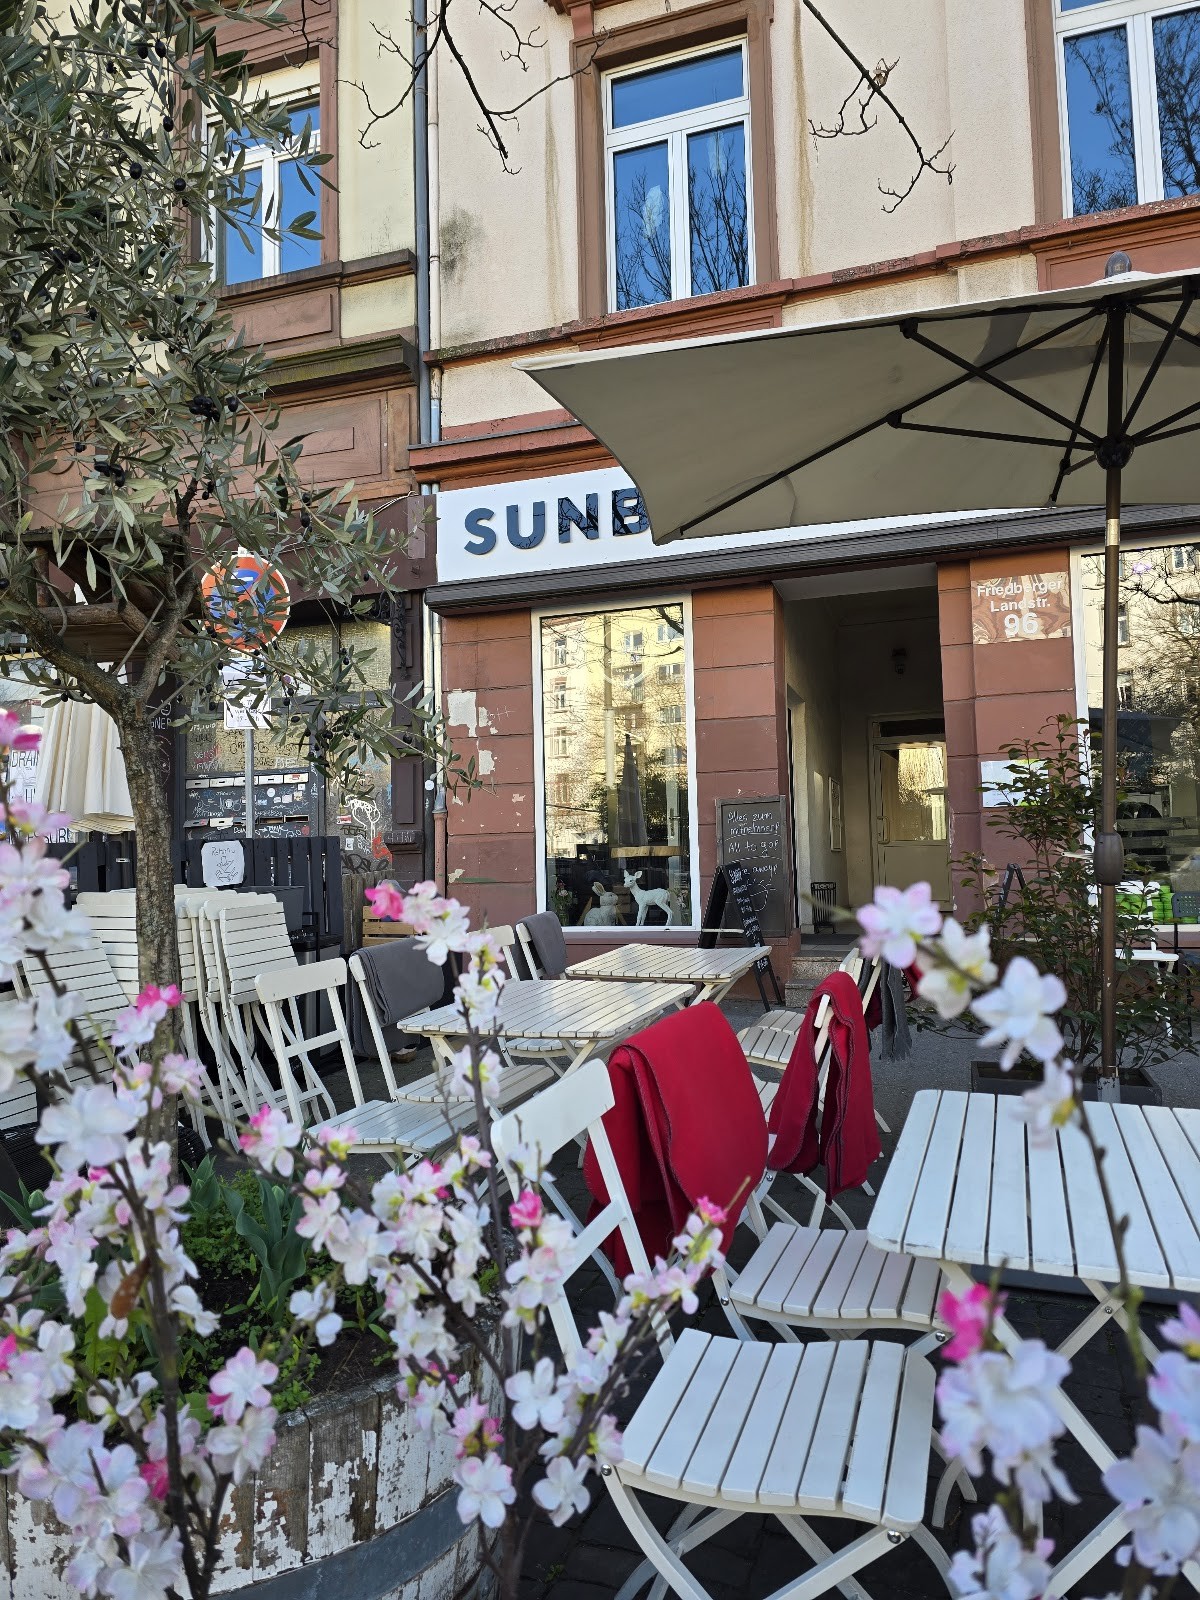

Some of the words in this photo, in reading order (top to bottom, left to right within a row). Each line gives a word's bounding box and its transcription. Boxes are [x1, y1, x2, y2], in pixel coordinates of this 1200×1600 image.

[464, 488, 650, 555] SUNB
[976, 580, 1062, 597] Friedberger
[990, 596, 1051, 612] Landstr.
[1004, 612, 1039, 638] 96
[727, 811, 748, 824] Alles
[752, 812, 773, 822] zum
[728, 842, 741, 853] All
[745, 840, 757, 852] to
